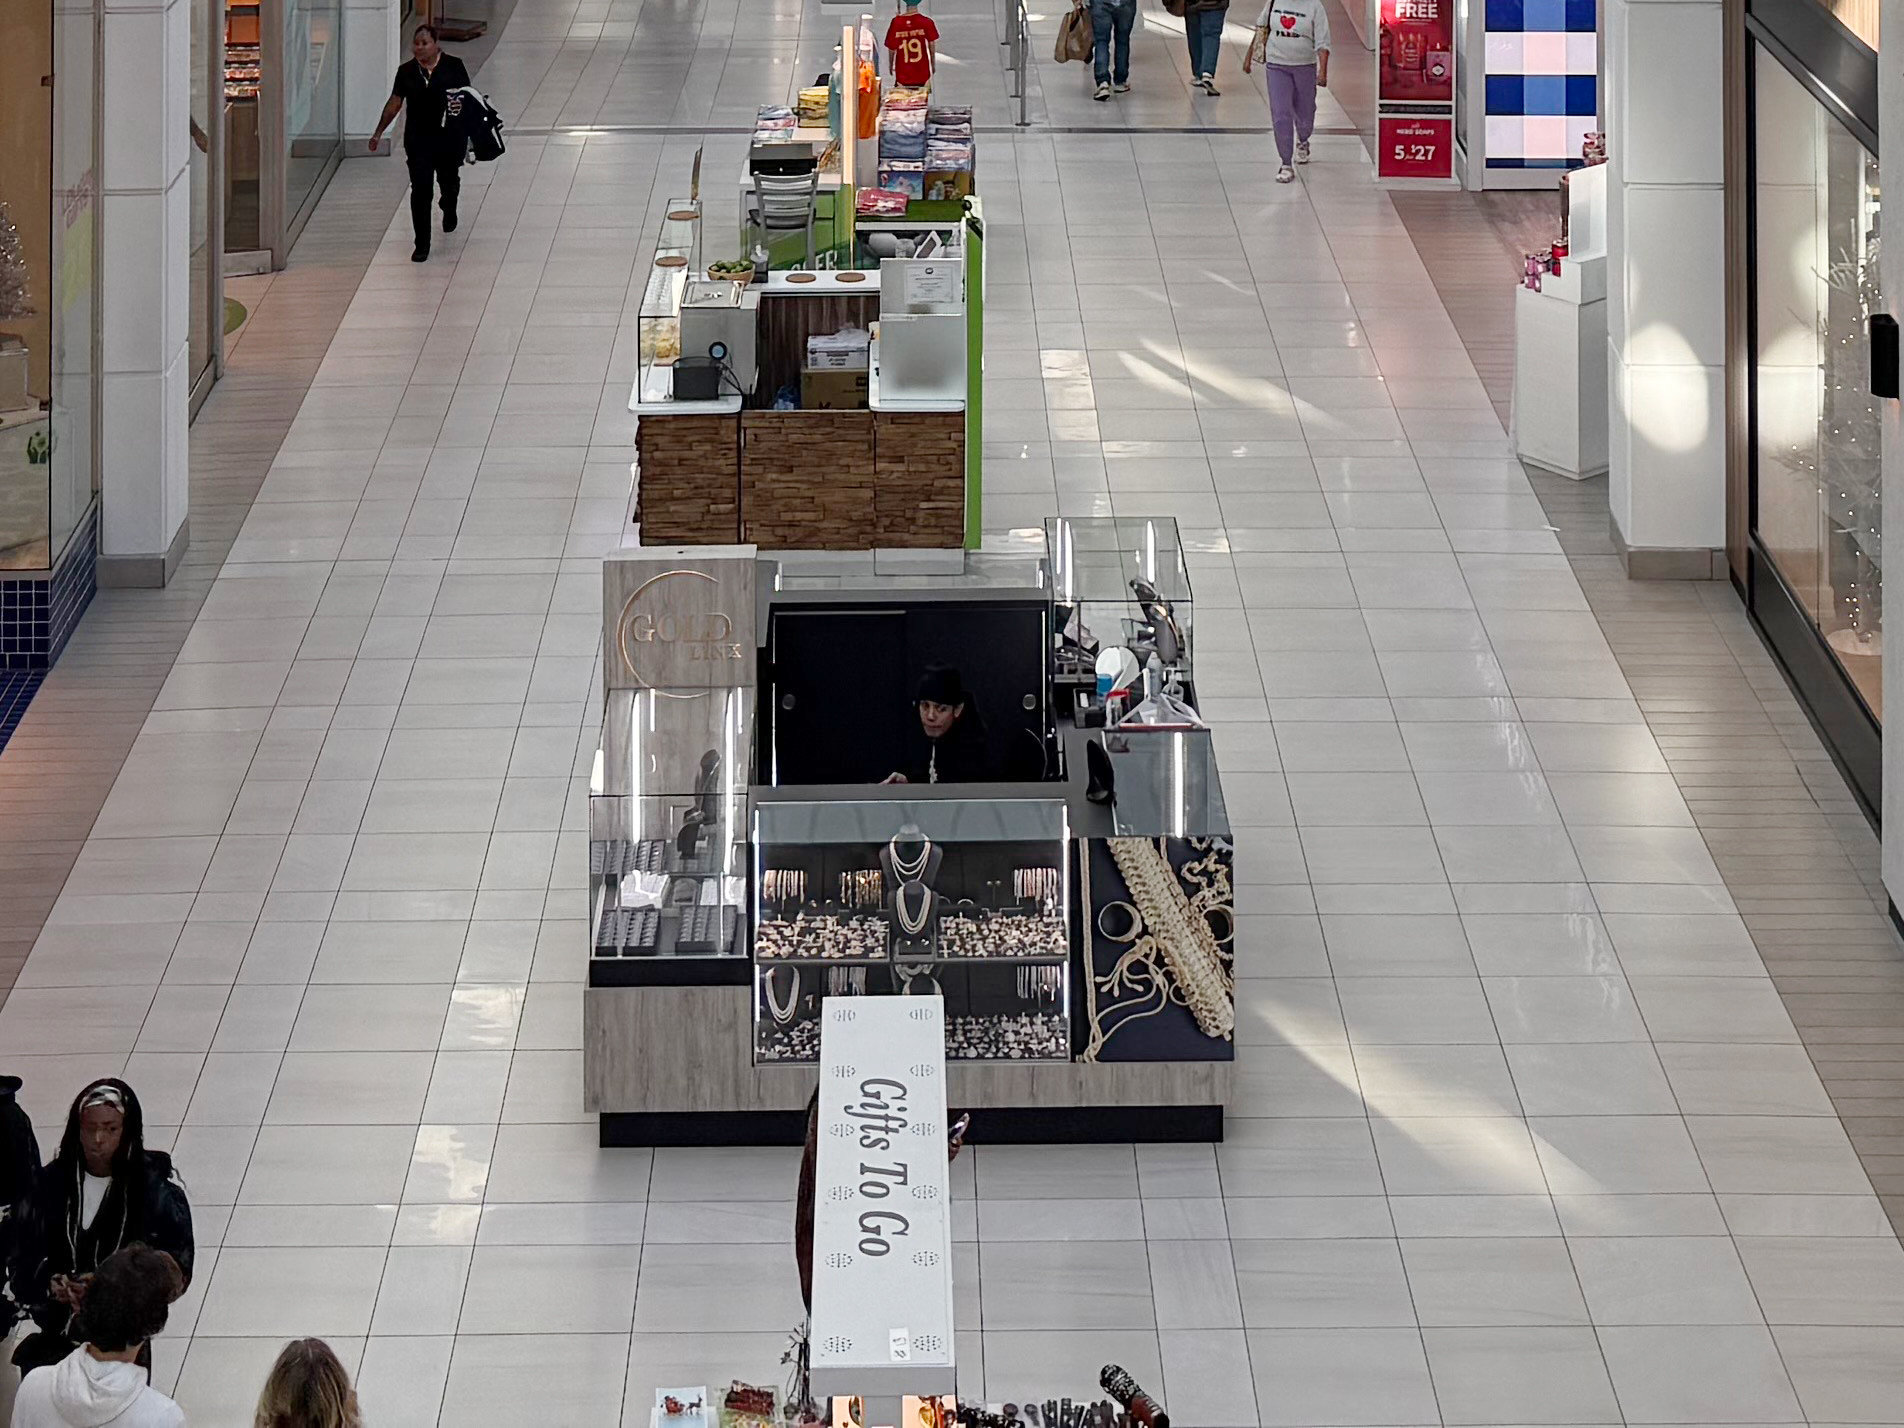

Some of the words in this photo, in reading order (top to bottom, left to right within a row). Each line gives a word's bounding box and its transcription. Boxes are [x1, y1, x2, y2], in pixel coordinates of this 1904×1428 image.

[1395, 3, 1439, 19] FREE
[898, 38, 923, 64] 19
[1394, 145, 1405, 160] 5
[631, 612, 733, 644] GOLD
[690, 643, 743, 661] LINX
[843, 1078, 908, 1152] Gifts
[859, 1161, 909, 1200] To
[858, 1210, 910, 1258] Go
